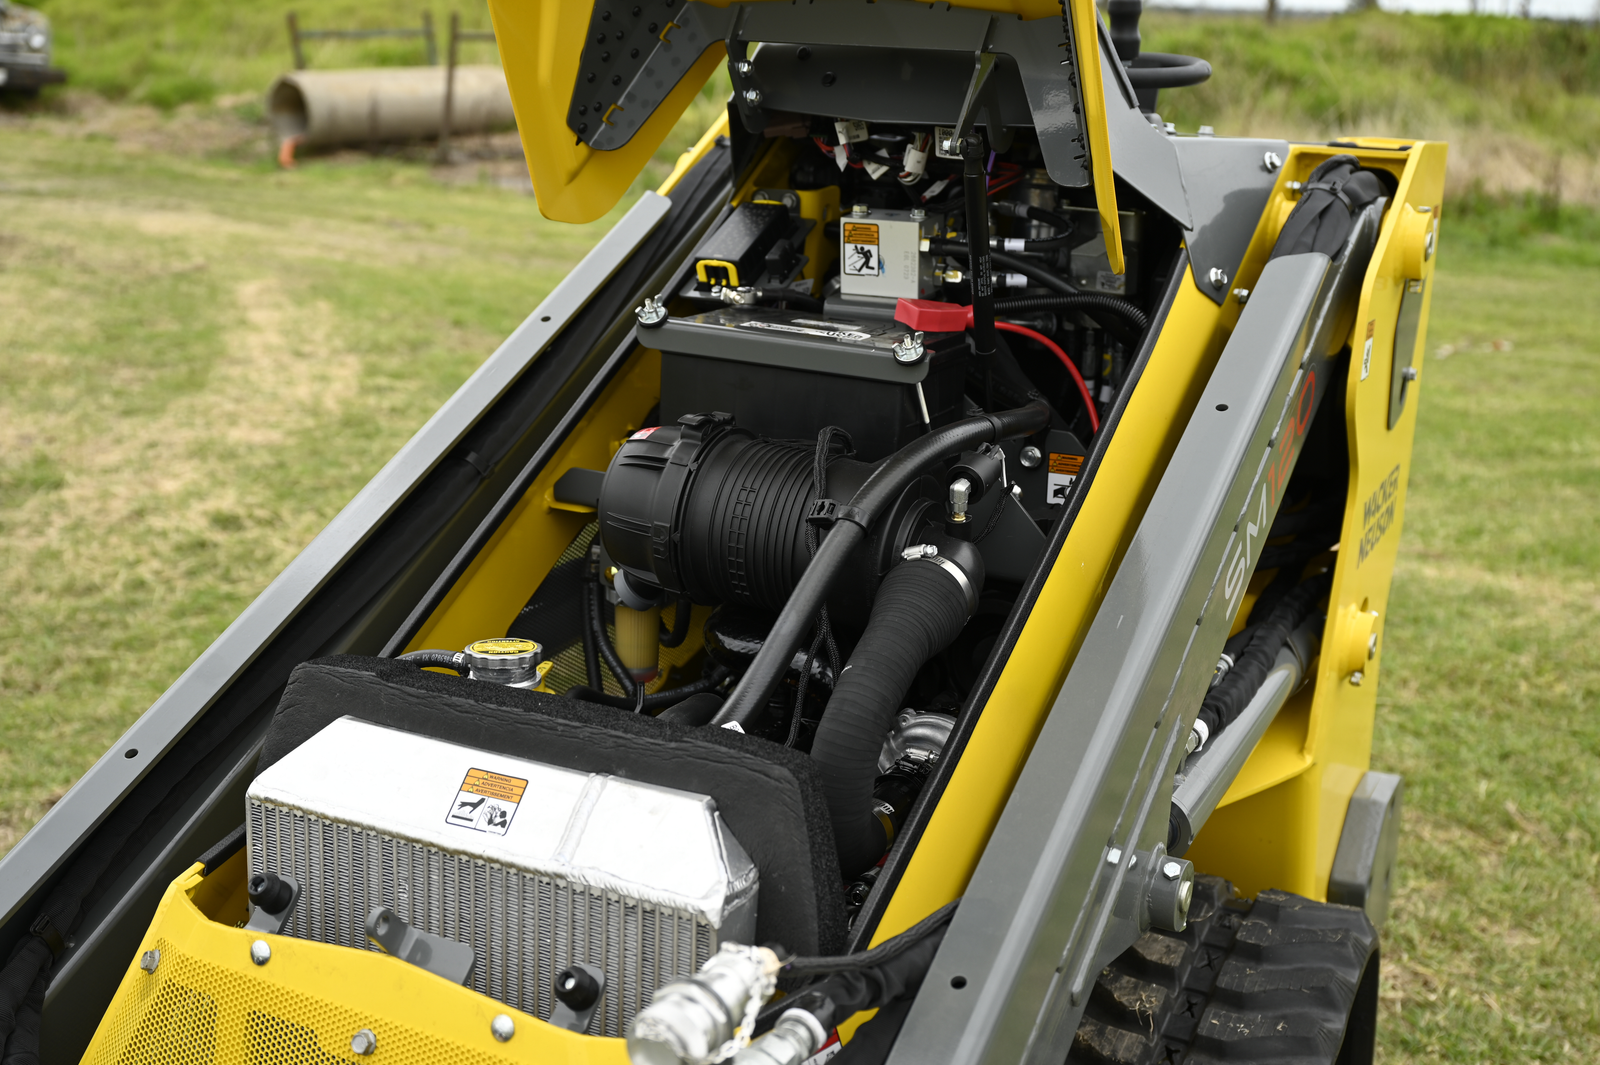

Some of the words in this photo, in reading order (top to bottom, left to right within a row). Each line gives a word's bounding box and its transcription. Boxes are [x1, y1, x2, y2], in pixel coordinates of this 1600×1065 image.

[1224, 369, 1316, 621] SM120
[1363, 462, 1400, 531] WACKER
[1356, 494, 1398, 570] NEUSON
[475, 788, 514, 800] AVERTISSEMENT
[481, 781, 514, 792] ADVERTENCIA
[489, 774, 512, 784] WARNING
